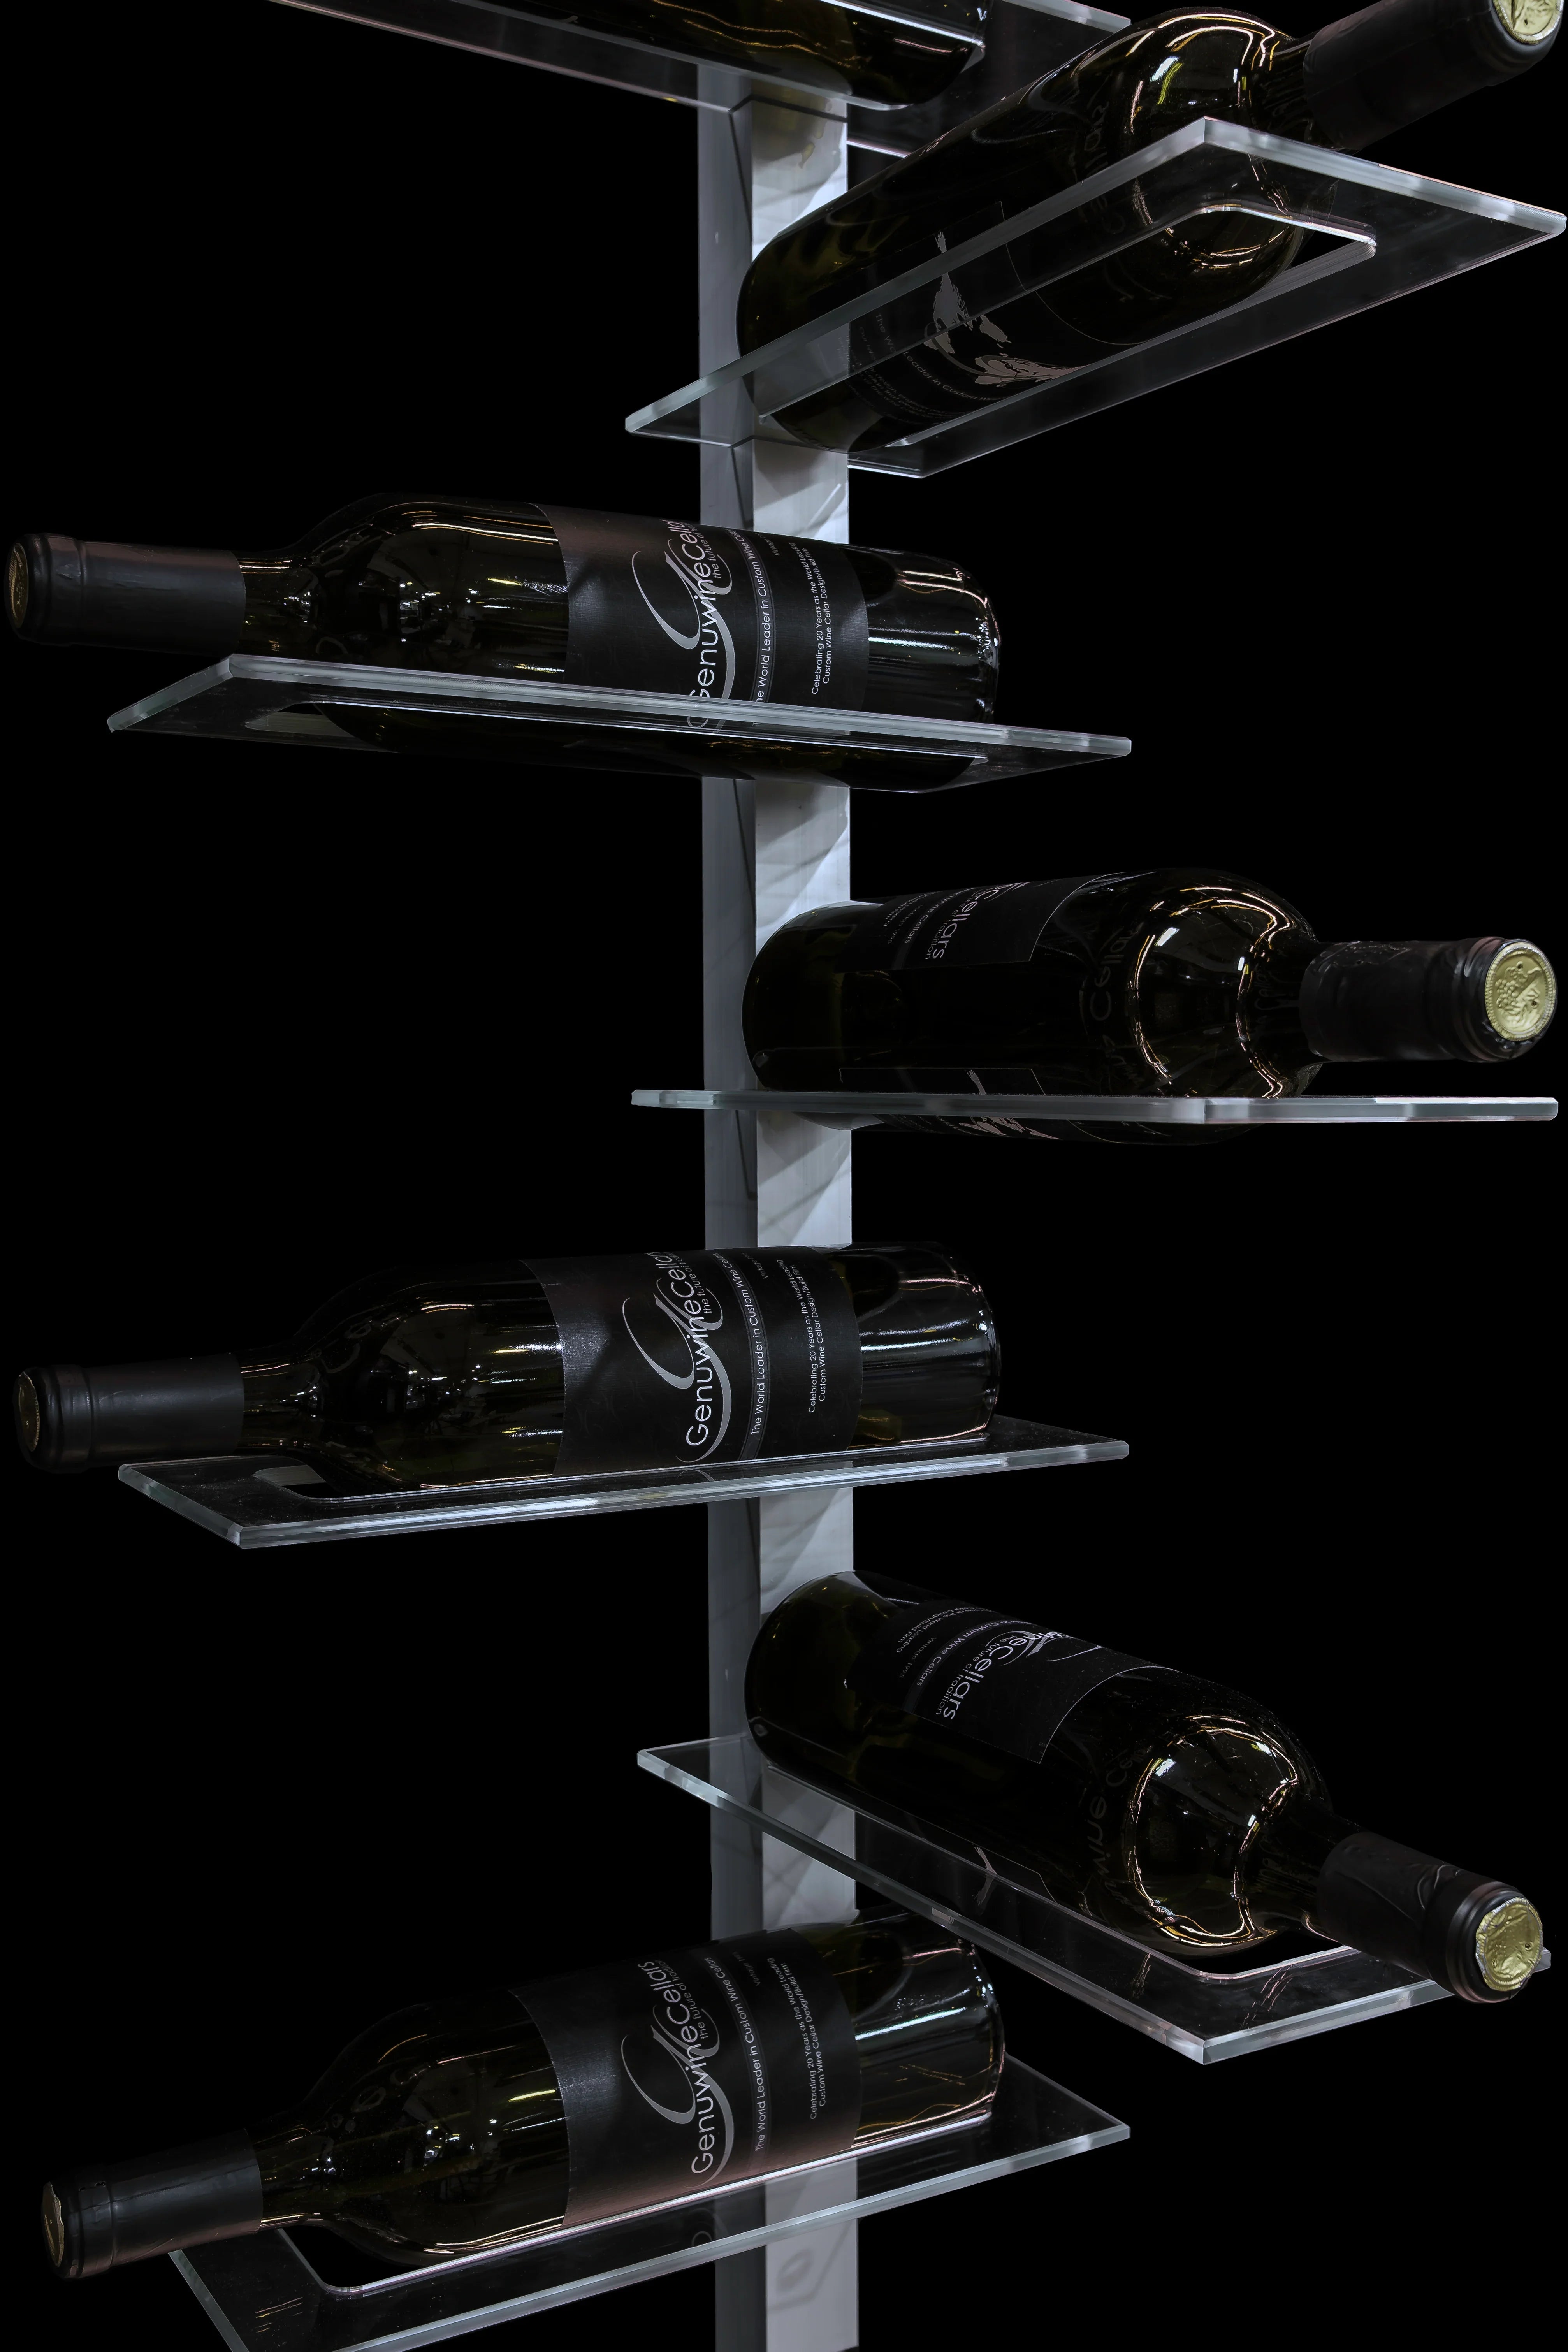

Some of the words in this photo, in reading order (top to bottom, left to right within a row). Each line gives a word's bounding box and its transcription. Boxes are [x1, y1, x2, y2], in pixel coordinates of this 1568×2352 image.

[903, 351, 933, 379] Leader
[942, 385, 977, 400] Custom
[701, 540, 716, 561] future
[742, 543, 756, 559] Wine
[712, 563, 721, 578] the
[752, 561, 767, 597] Custom
[801, 561, 814, 580] World
[808, 559, 828, 599] Design/Build
[760, 600, 770, 609] in
[813, 596, 820, 605] as
[823, 601, 831, 625] Cellar
[761, 612, 770, 651] Leader
[816, 630, 823, 641] 20
[757, 654, 770, 687] World
[812, 643, 824, 694] Celebrating
[823, 650, 832, 684] Custom
[905, 915, 928, 943] Cellars
[925, 920, 951, 960] tradition
[712, 1253, 732, 1268] Cellars
[776, 1260, 795, 1280] Leading
[790, 1265, 801, 1275] Firm
[689, 1273, 706, 1296] future
[730, 1269, 744, 1288] Wine
[790, 1281, 803, 1300] World
[796, 1276, 818, 1318] Design/Build
[702, 1298, 712, 1314] the
[741, 1289, 758, 1325] Custom
[805, 1316, 811, 1325] as
[752, 1329, 761, 1338] in
[807, 1326, 815, 1349] Years
[814, 1320, 823, 1344] Cellar
[754, 1340, 765, 1380] Leader
[810, 1351, 816, 1361] 20
[754, 1383, 765, 1414] World
[809, 1363, 818, 1413] Celebrating
[751, 1417, 761, 1435] The
[922, 1617, 944, 1630] World
[963, 1622, 1000, 1637] Custom
[896, 1630, 923, 1653] Leading
[898, 1631, 913, 1643] Firm
[941, 1637, 965, 1655] Wine
[911, 1637, 937, 1660] Vintage
[972, 1642, 1001, 1662] future
[917, 1656, 942, 1686] Cellars
[962, 1663, 972, 1673] of
[935, 1673, 965, 1716] tradition
[654, 1959, 680, 1981] tradition
[704, 1957, 726, 1978] Cellars
[780, 1963, 793, 1976] Firm
[722, 1979, 738, 2002] Wine
[781, 1983, 796, 2005] World
[788, 1976, 813, 2022] Design/Build
[684, 1992, 701, 2020] future
[793, 2007, 802, 2020] the
[698, 2022, 709, 2039] the
[735, 2003, 754, 2043] Custom
[799, 2021, 806, 2031] as
[802, 2032, 812, 2057] Years
[809, 2024, 819, 2049] Cellar
[749, 2045, 758, 2056] in
[806, 2058, 814, 2069] 20
[753, 2058, 765, 2099] Leader
[809, 2070, 817, 2119] Celebrating
[757, 2101, 766, 2133] World
[755, 2134, 765, 2152] The
